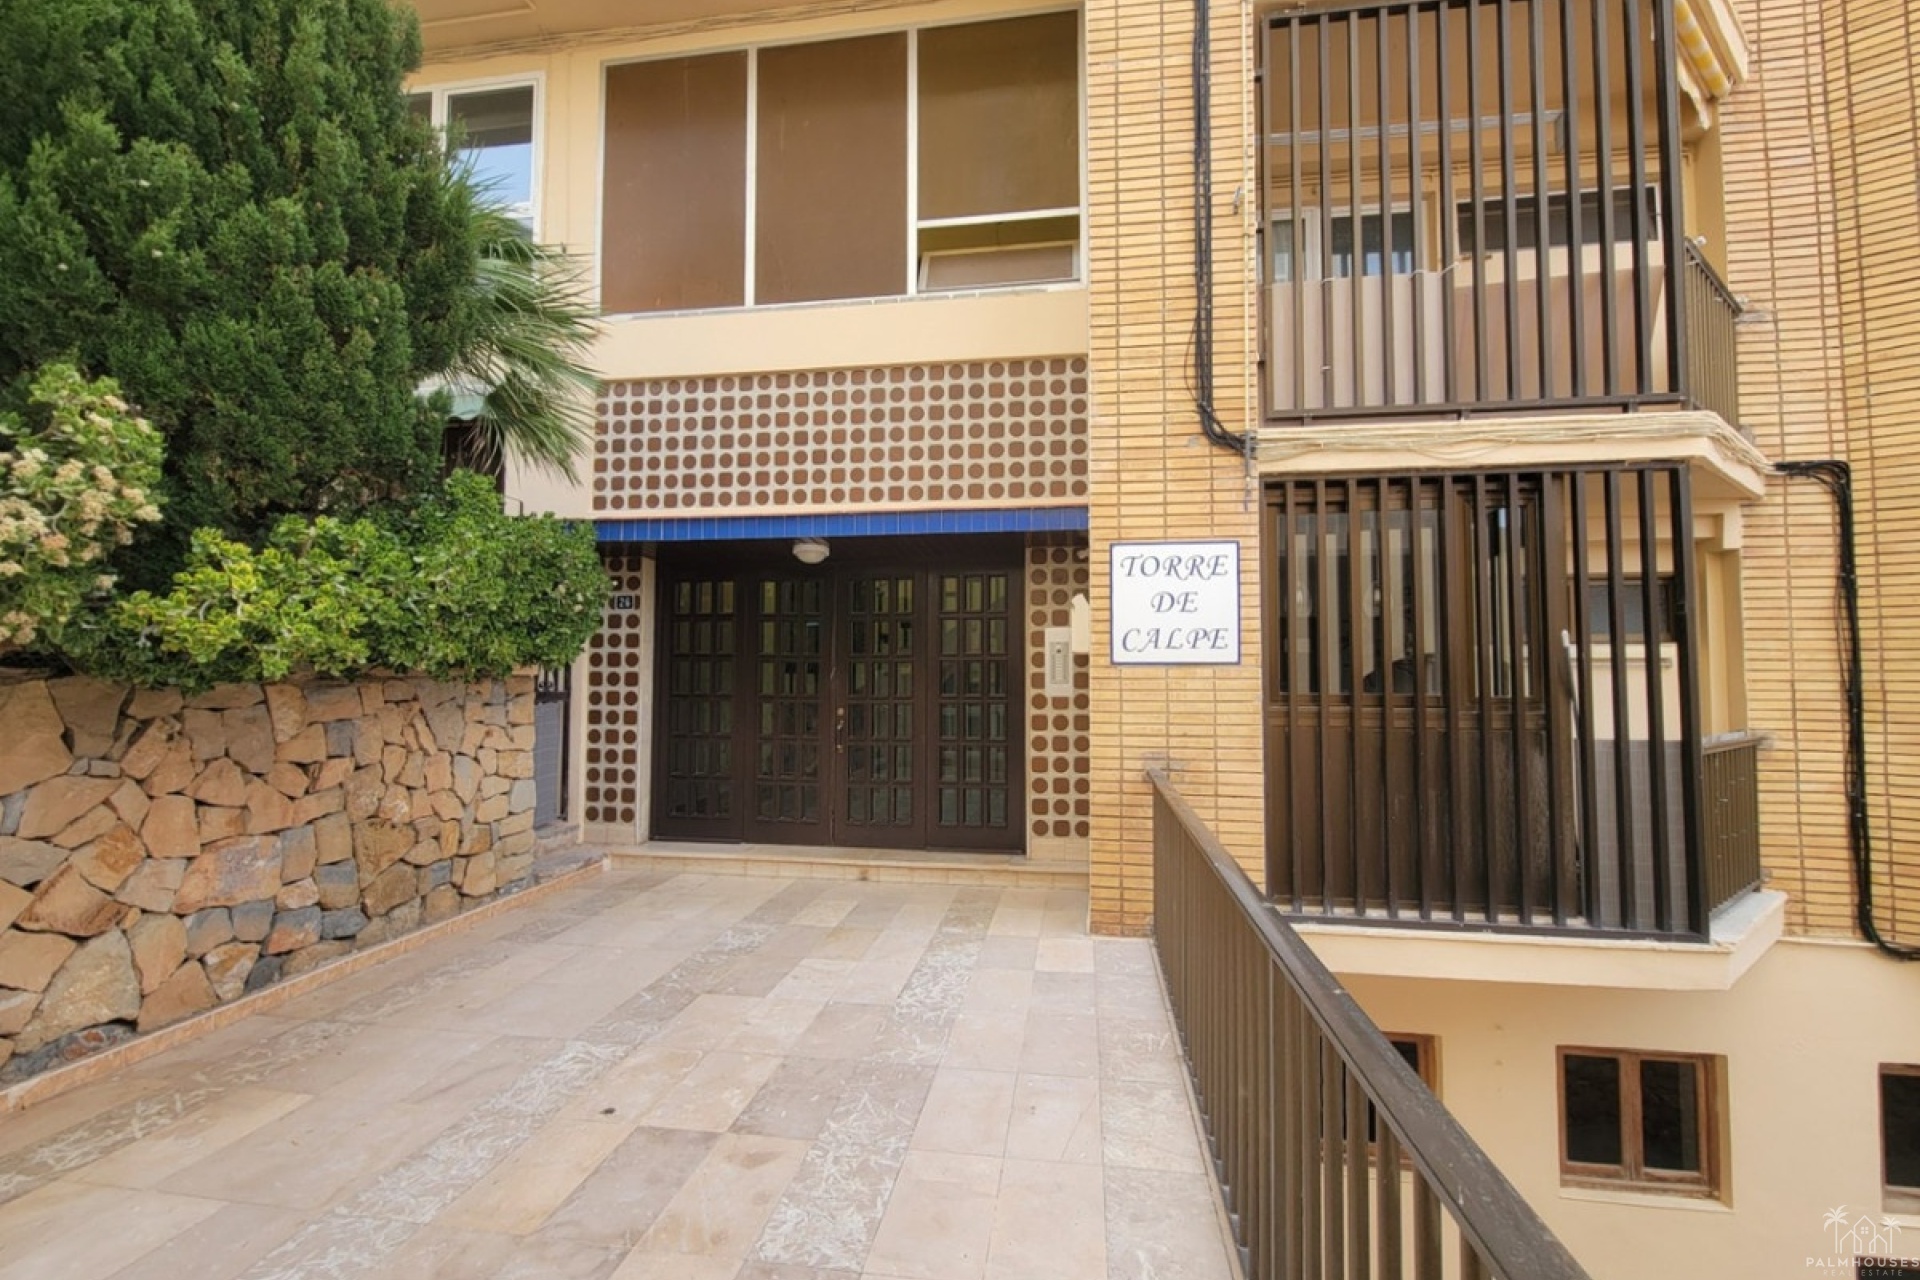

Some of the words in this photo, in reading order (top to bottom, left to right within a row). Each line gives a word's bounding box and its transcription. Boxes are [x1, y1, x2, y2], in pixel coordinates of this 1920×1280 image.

[1120, 554, 1229, 580] TORRE
[1151, 591, 1198, 613] DE
[1122, 628, 1229, 652] CALPE
